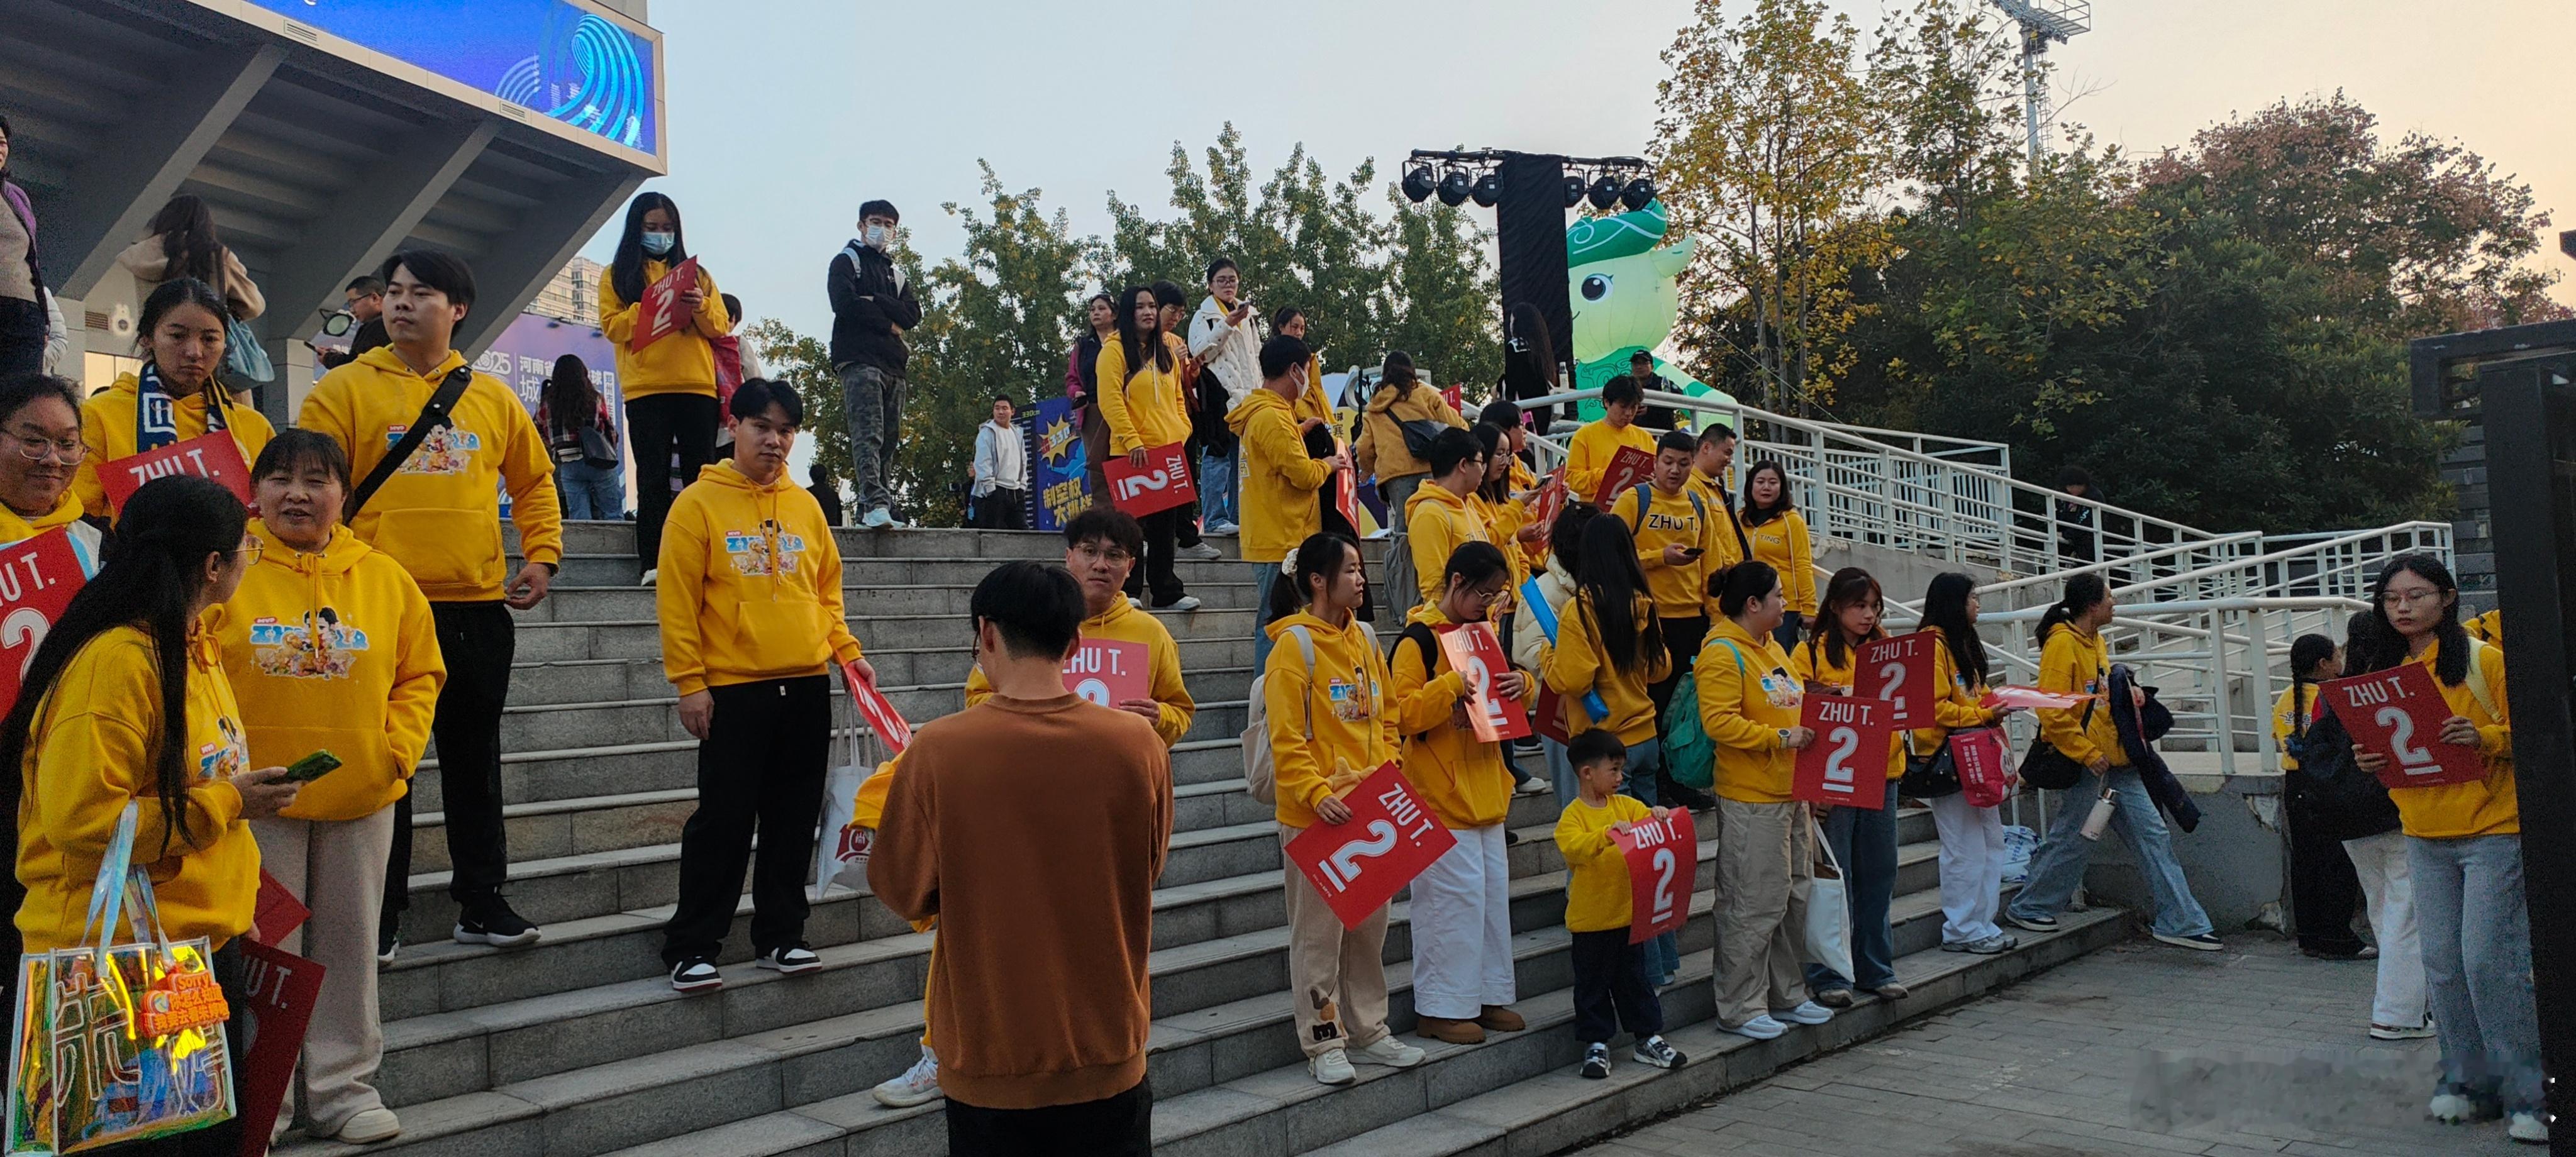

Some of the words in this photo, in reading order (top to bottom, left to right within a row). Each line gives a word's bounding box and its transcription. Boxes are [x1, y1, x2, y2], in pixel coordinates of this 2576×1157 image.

[652, 274, 673, 299] ZHU
[676, 267, 685, 282] T.
[652, 288, 675, 329] 2
[187, 448, 219, 478] T.
[1165, 455, 1184, 480] ZHU
[1620, 451, 1640, 465] ZHU
[1639, 457, 1650, 468] T.
[1043, 477, 1082, 509] 制空权
[1124, 469, 1169, 498] 2
[1172, 480, 1189, 494] T.
[1608, 467, 1634, 500] 2
[1053, 494, 1093, 528] 大挑战
[1648, 514, 1684, 531] ZHU
[1687, 517, 1698, 531] T.
[1760, 534, 1781, 545] TING
[20, 551, 55, 590] T.
[1452, 631, 1474, 652] ZHU
[1472, 630, 1489, 651] T.
[1870, 642, 1901, 663] ZHU
[1905, 639, 1918, 656] T.
[1108, 648, 1126, 675] T.
[1468, 656, 1502, 716] 2
[1879, 662, 1906, 710] 2
[2343, 680, 2389, 707] ZHU
[2387, 676, 2415, 699] T.
[1819, 701, 1855, 723] ZHU
[1860, 705, 1874, 726] T.
[2375, 706, 2433, 765] 2
[1824, 726, 1858, 782] 2
[1378, 782, 1421, 826] ZHU
[1409, 818, 1434, 847] T.
[1630, 821, 1665, 850] ZHU
[1666, 817, 1682, 841] T.
[1330, 819, 1397, 883] 2
[1653, 848, 1675, 913] 2
[169, 985, 223, 1011] 你怎么知道
[178, 974, 211, 990] Sorry
[271, 966, 292, 1009] T.
